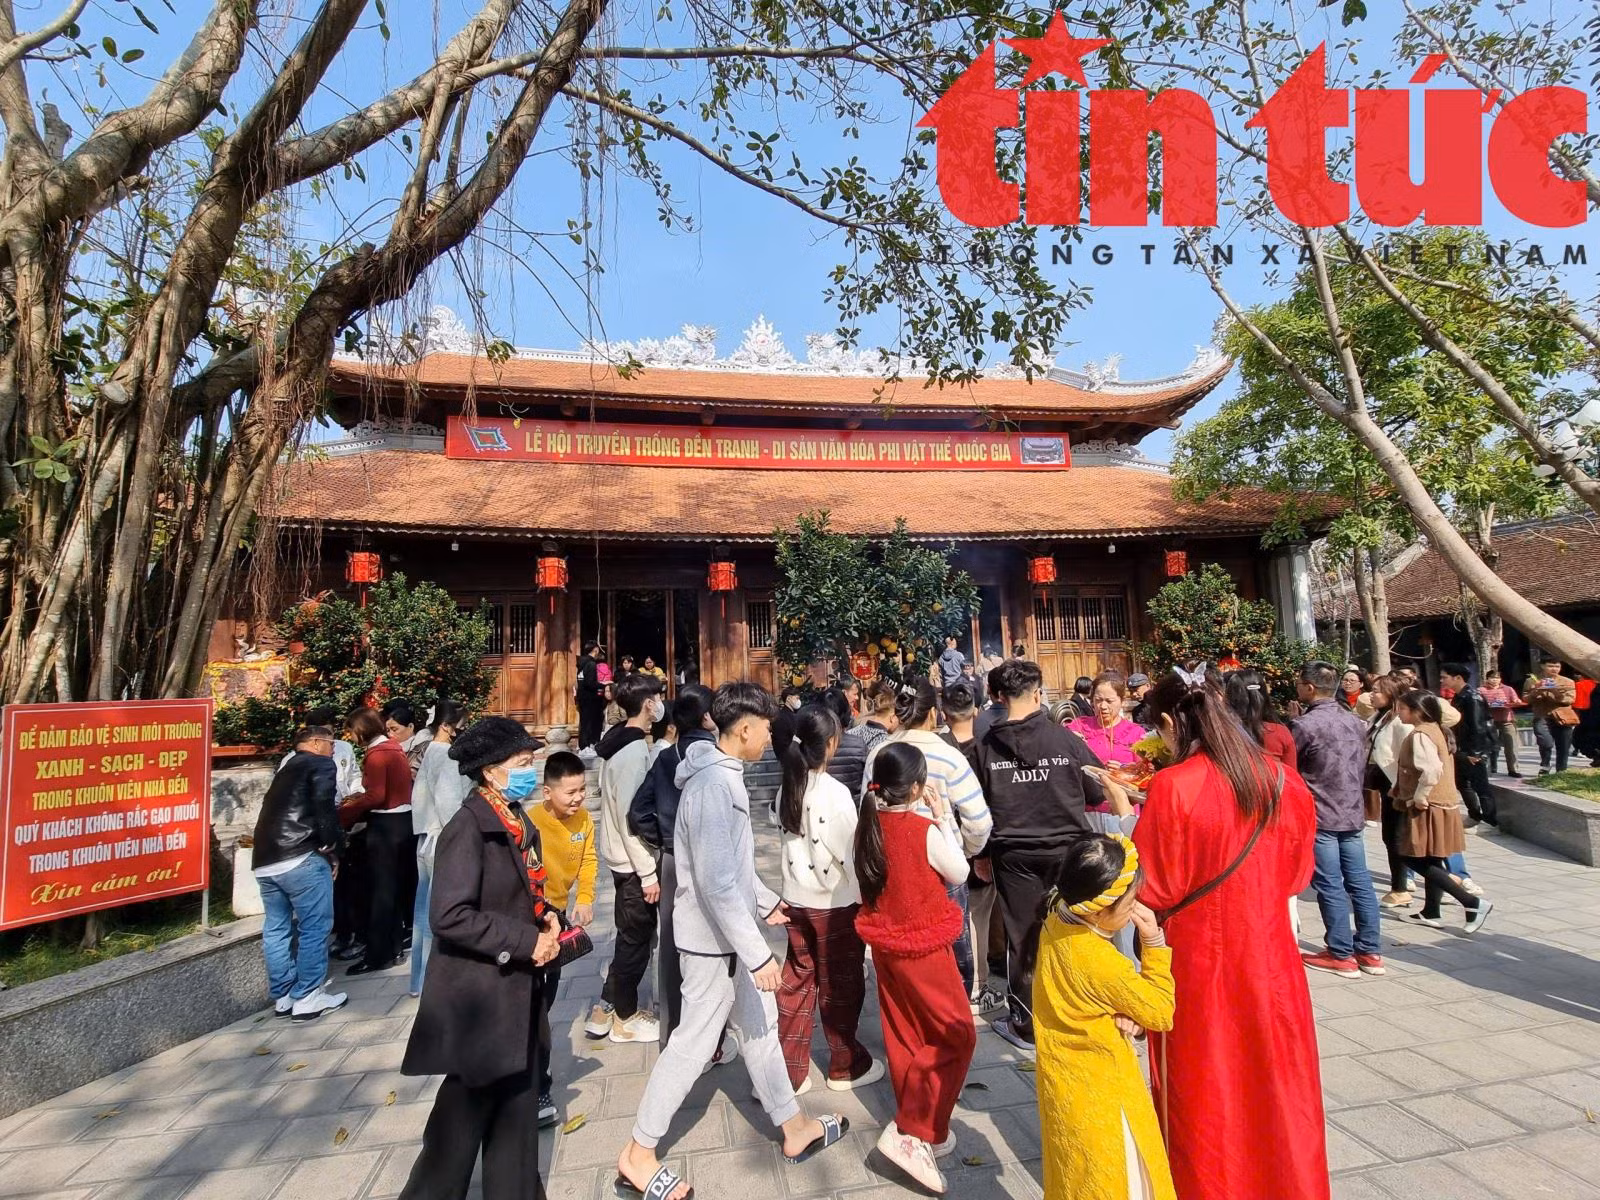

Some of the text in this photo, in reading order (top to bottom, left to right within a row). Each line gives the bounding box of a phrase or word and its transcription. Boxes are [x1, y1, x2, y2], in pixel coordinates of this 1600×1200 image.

[525, 425, 543, 453] LỄ
[546, 429, 572, 458] HỘI
[634, 430, 681, 458] THỐNG
[684, 432, 712, 458] ĐỀN
[716, 438, 760, 459] TRANH
[772, 440, 786, 460] DI
[789, 434, 817, 460] SẢN
[820, 437, 847, 461] VĂN
[849, 438, 876, 461] HÓA
[879, 442, 900, 461] PHI
[903, 439, 926, 465] VẬT
[929, 435, 952, 461] THỂ
[954, 436, 988, 464] QUỐC
[990, 443, 1012, 462] GIA
[69, 722, 94, 747] BẢO
[96, 723, 110, 748] VỆ
[112, 726, 139, 744] SINH
[141, 721, 162, 742] MÔI
[35, 758, 84, 780] XANH
[100, 753, 144, 776] SẠCH
[158, 750, 188, 771] ĐẸP
[991, 758, 1018, 770] acmé
[1051, 754, 1070, 766] vie
[1011, 769, 1050, 784] ADLV
[32, 788, 73, 811] TRONG
[75, 782, 114, 805] KHUÔN
[117, 779, 142, 800] VIÊN
[143, 776, 166, 797] NHÀ
[14, 819, 40, 846] QUÝ
[42, 816, 83, 841] KHÁCH
[85, 811, 124, 835] KHÔNG
[150, 806, 171, 828] GẠO
[173, 797, 200, 822] MUỐI
[29, 848, 70, 874] TRONG
[72, 841, 112, 867] KHUÔN
[114, 837, 140, 859] VIÊN
[141, 832, 164, 855] NHÀ
[31, 881, 82, 906] Xin
